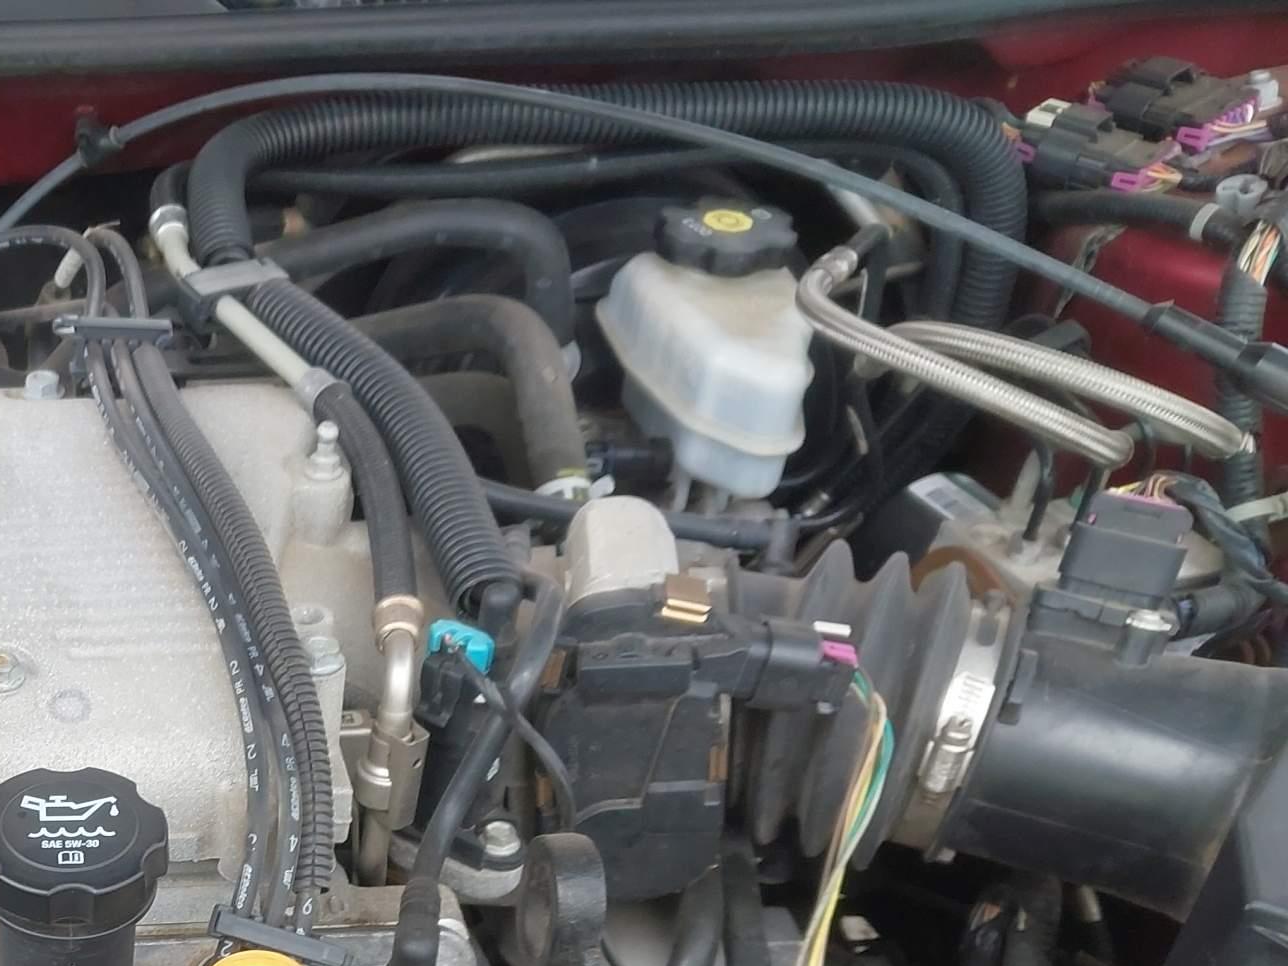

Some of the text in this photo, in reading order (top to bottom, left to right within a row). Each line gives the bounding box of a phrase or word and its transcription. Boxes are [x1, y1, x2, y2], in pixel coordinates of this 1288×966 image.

[234, 679, 245, 695] PR
[41, 839, 99, 849] SAE 5W-30
